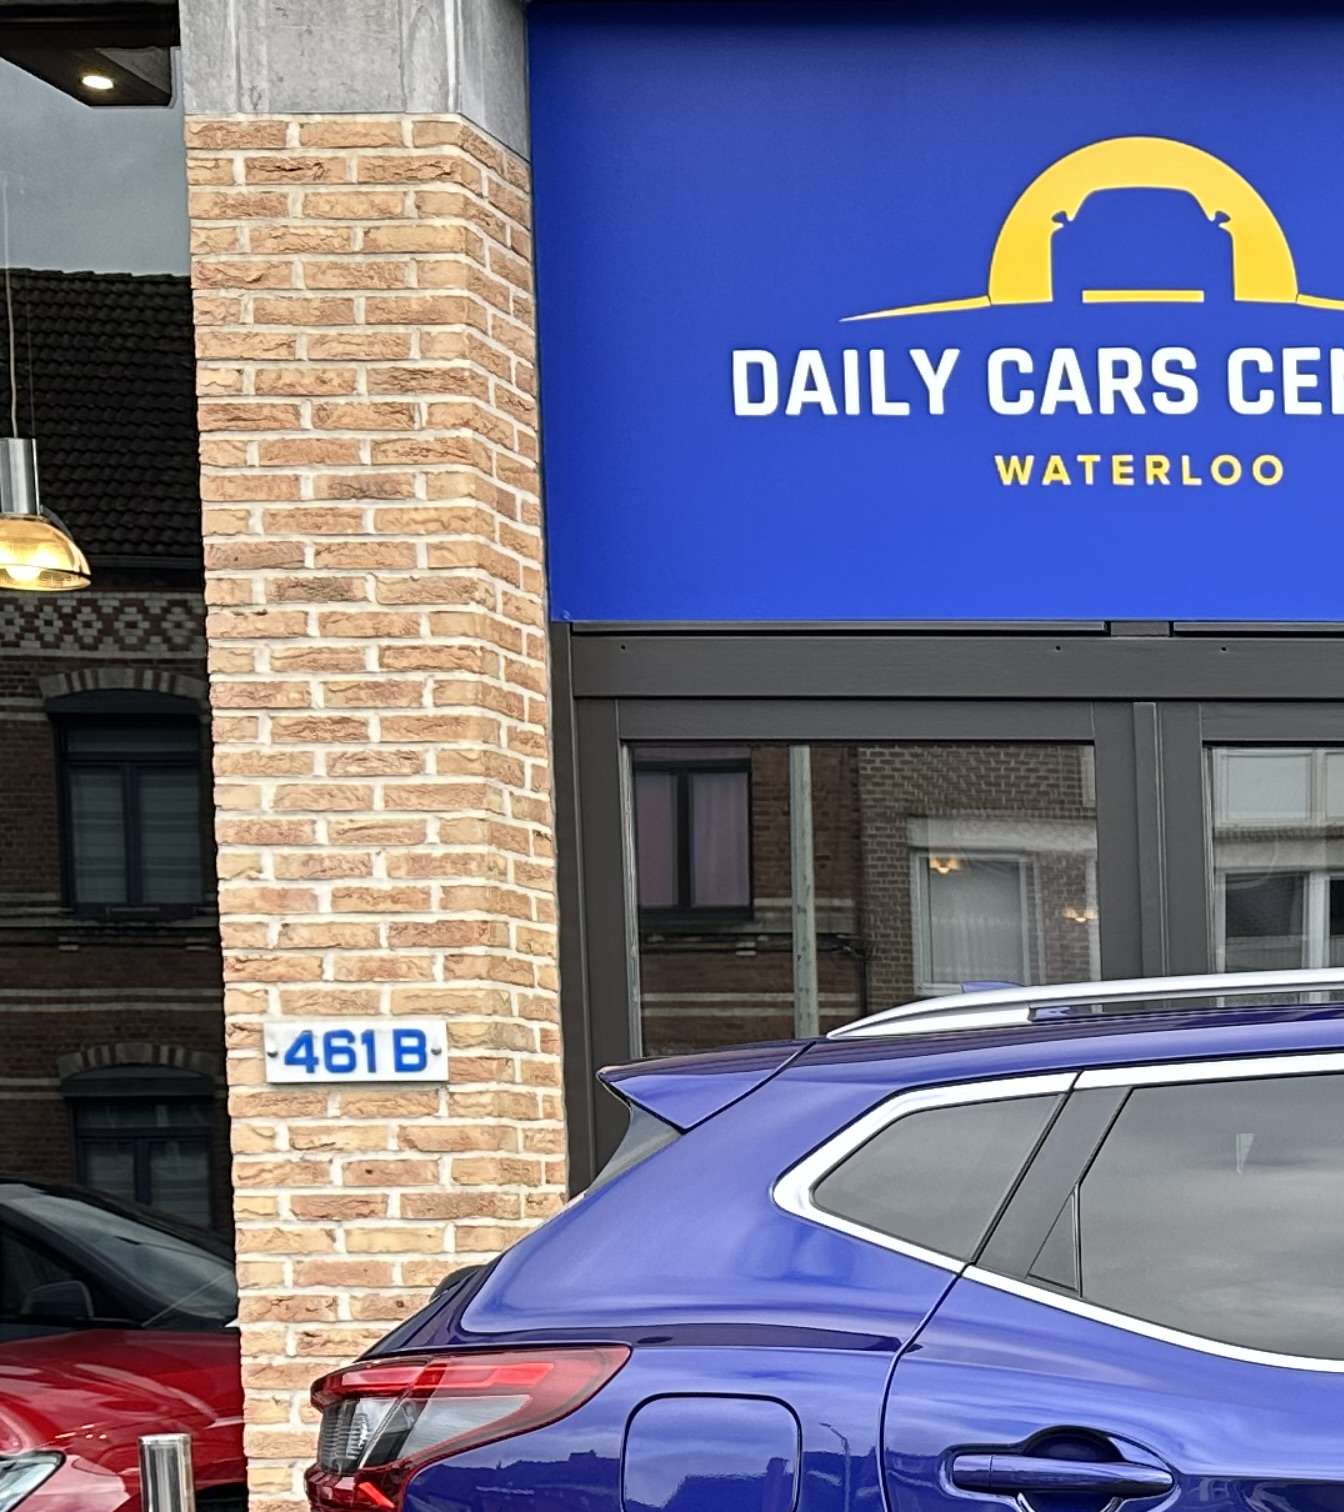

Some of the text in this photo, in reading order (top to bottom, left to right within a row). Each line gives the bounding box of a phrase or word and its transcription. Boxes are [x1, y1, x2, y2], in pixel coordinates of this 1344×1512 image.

[731, 347, 961, 416] DAILY
[987, 346, 1200, 416] CARS
[994, 453, 1285, 487] WATERLOO
[284, 1028, 428, 1074] 461 B
